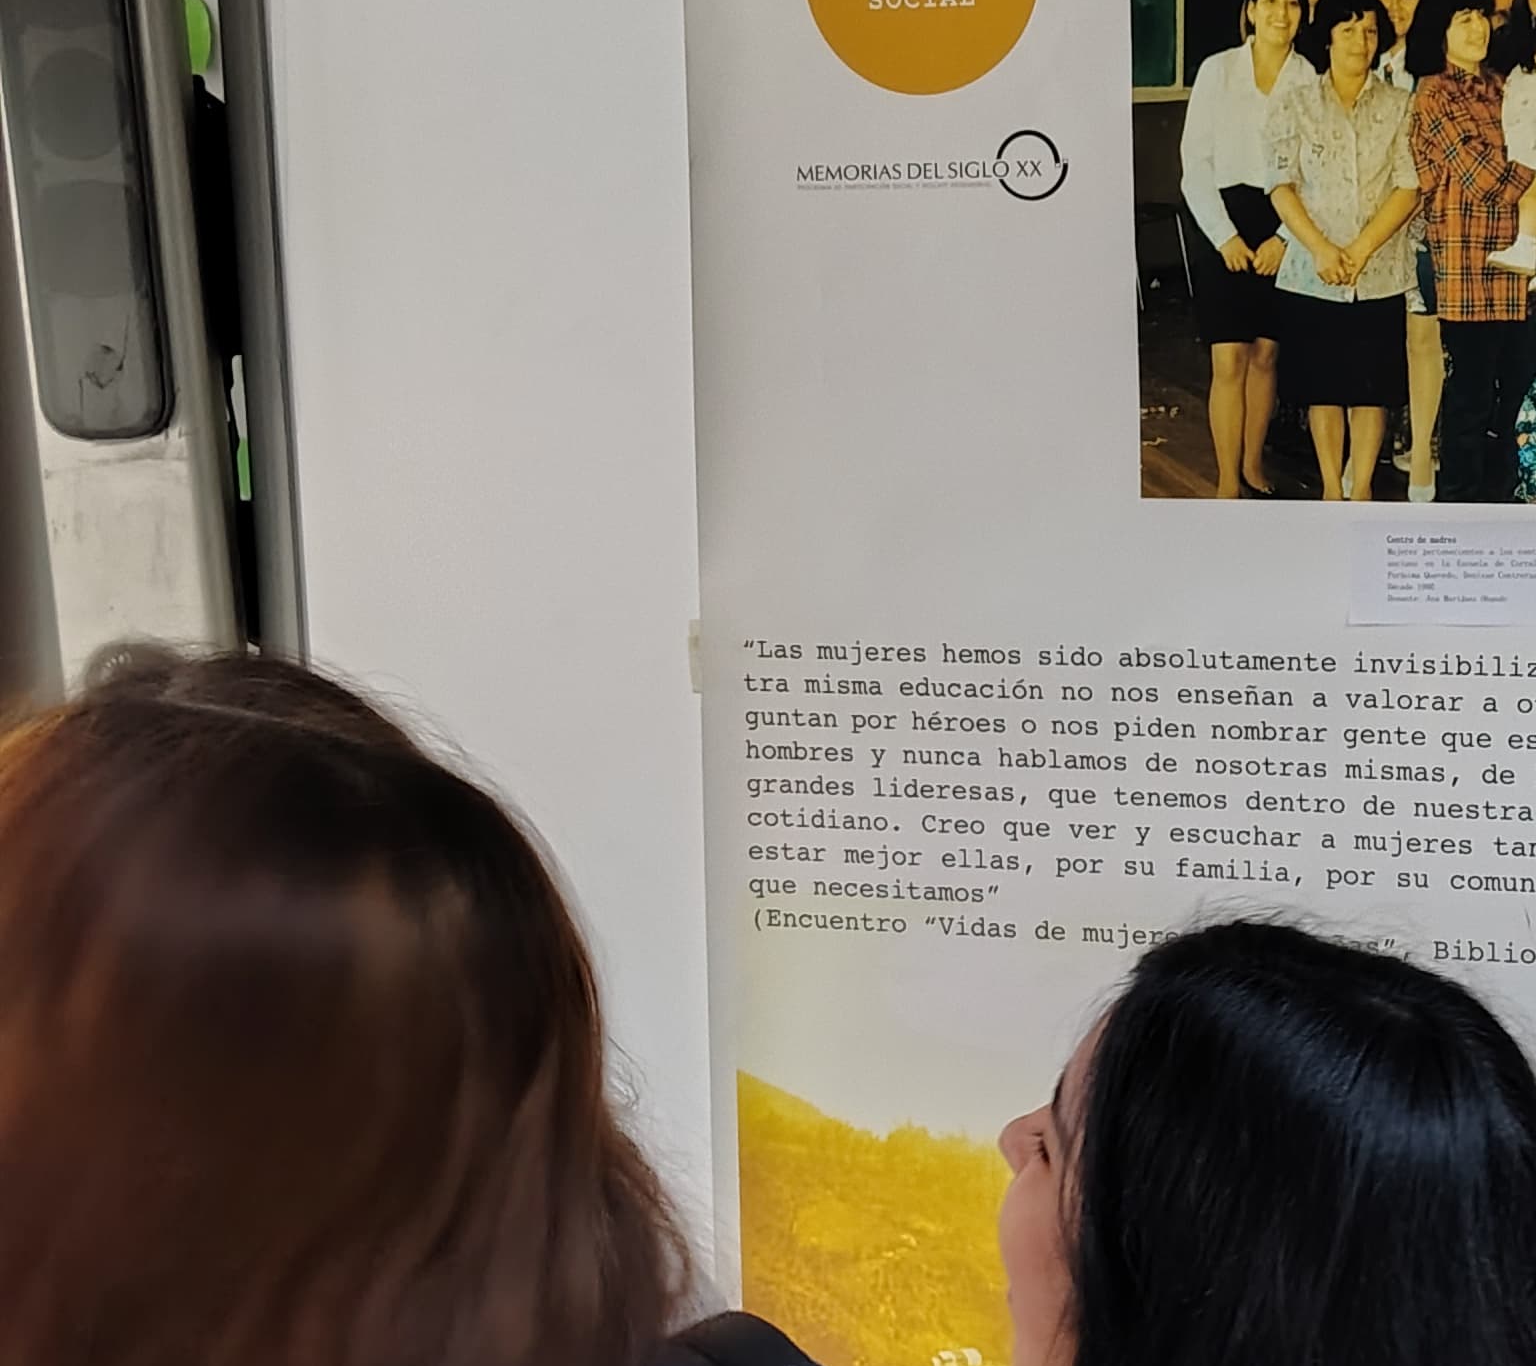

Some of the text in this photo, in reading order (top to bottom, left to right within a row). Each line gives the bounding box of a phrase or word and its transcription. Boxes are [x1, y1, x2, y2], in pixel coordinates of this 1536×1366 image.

[797, 160, 1042, 181] MEMORIAS DEL SIGLO XX
[815, 639, 927, 667] mujeres
[941, 642, 1022, 666] hemos
[1038, 643, 1104, 668] sido
[1117, 646, 1337, 674] absolutamente
[743, 672, 791, 694] tra
[803, 672, 884, 697] misma
[898, 676, 1045, 701] educación
[1060, 685, 1094, 702] no
[1109, 686, 1160, 704] nos
[1176, 684, 1295, 707] enseñan
[1311, 691, 1329, 708] a
[1344, 687, 1465, 713] valorar
[1482, 696, 1500, 714] a
[744, 707, 840, 732] guntan
[849, 714, 899, 735] por
[911, 709, 1007, 734] héroes
[1020, 718, 1038, 735] o
[1049, 719, 1099, 737] nos
[1112, 714, 1198, 743] piden
[1210, 719, 1329, 748] nombrar
[1343, 724, 1427, 750] gente
[1440, 731, 1493, 754] que
[744, 738, 855, 763] hombres
[869, 748, 888, 770] y
[901, 748, 984, 767] nunca
[996, 746, 1128, 772] hablamos
[1144, 751, 1178, 774] de
[1194, 755, 1328, 779] nosotras
[1343, 757, 1460, 788] mismas,
[1481, 762, 1516, 786] de
[746, 774, 855, 799] grandes
[872, 775, 1028, 807] lideresas,
[1047, 787, 1097, 810] que
[1112, 786, 1228, 811] tenemos
[1245, 789, 1346, 815] dentro
[1362, 794, 1396, 817] de
[1412, 799, 1535, 822] nuestra
[746, 806, 901, 833] cotidiano.
[920, 814, 986, 836] Creo
[1002, 820, 1051, 843] que
[1067, 823, 1118, 841] ver
[1133, 826, 1152, 848] y
[1169, 824, 1303, 848] escuchar
[1320, 832, 1337, 850] a
[1352, 829, 1473, 859] mujeres
[747, 842, 827, 863] estar
[842, 843, 924, 871] mejor
[940, 847, 1033, 876] ellas,
[1055, 856, 1105, 879] por
[1123, 859, 1156, 877] su
[1175, 856, 1303, 888] familia,
[1325, 868, 1376, 891] por
[1396, 871, 1430, 889] su
[748, 878, 797, 900] que
[753, 907, 908, 934] (Encuentro
[1034, 919, 1066, 942] de
[1081, 923, 1180, 950] mujer
